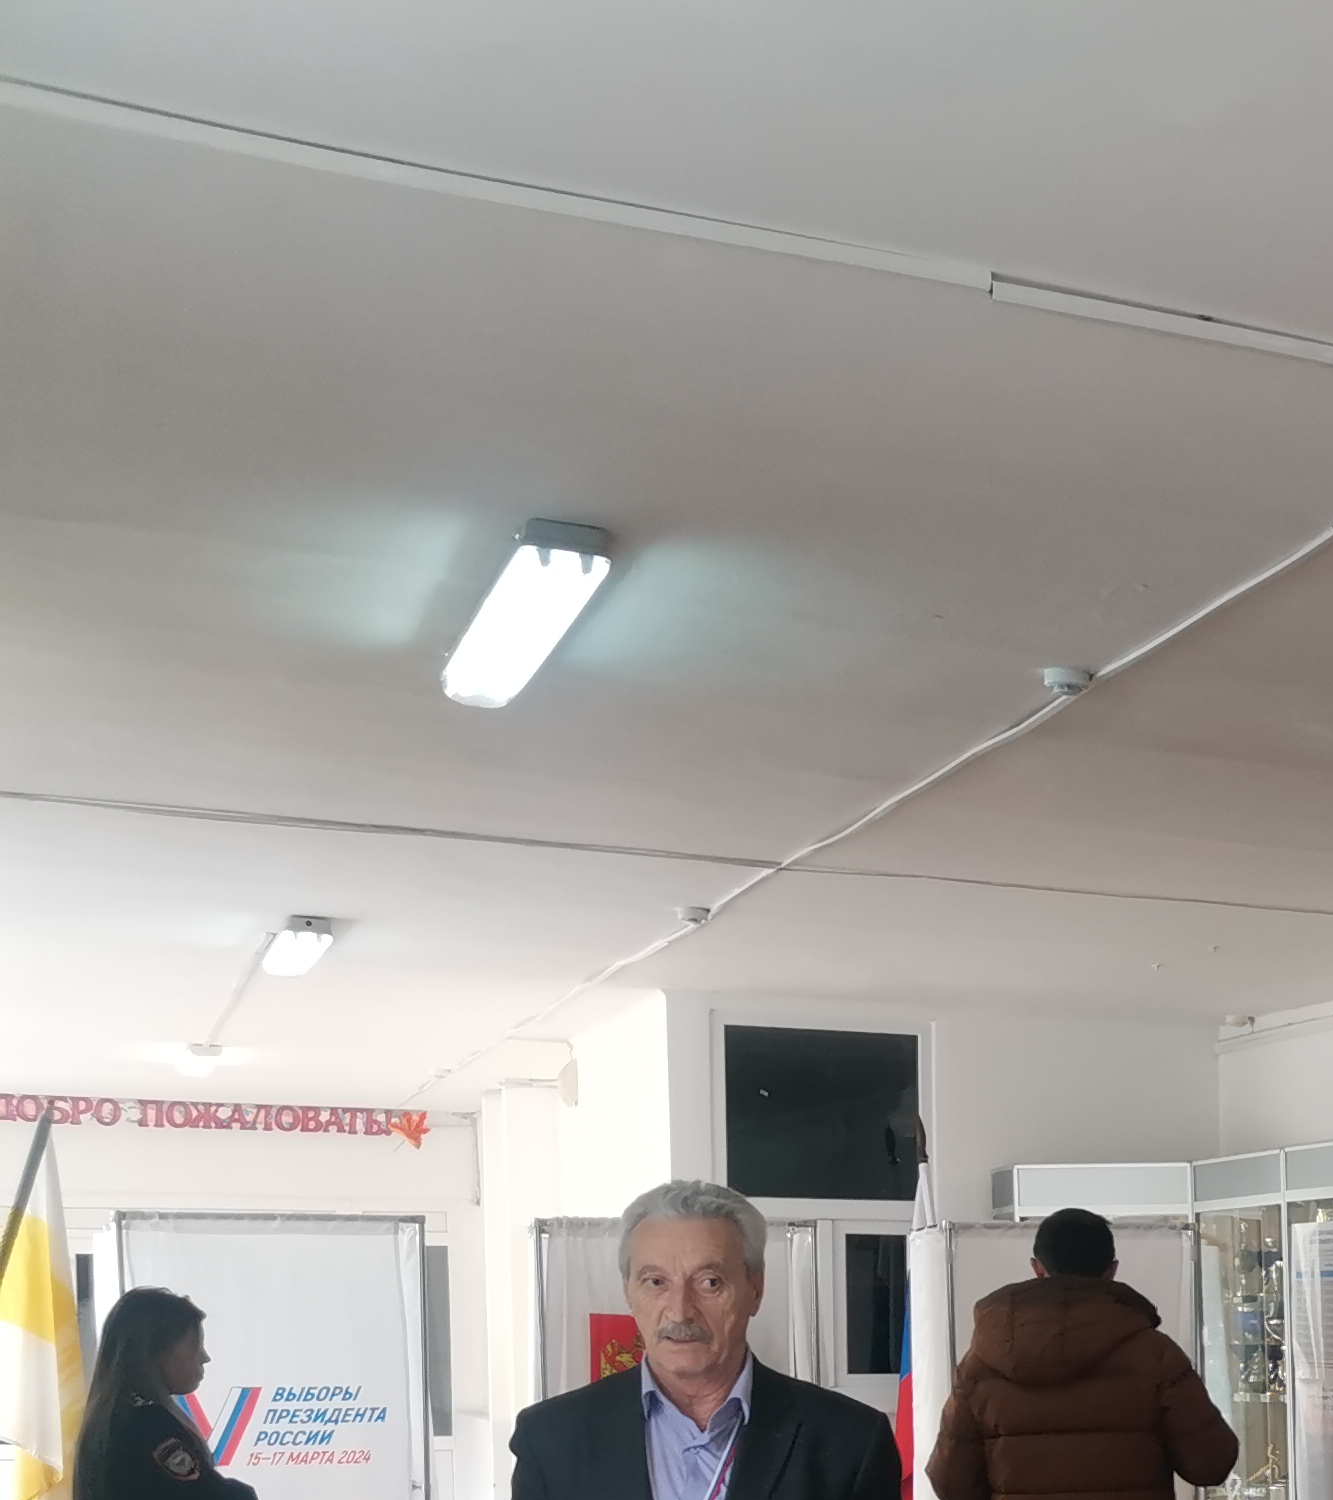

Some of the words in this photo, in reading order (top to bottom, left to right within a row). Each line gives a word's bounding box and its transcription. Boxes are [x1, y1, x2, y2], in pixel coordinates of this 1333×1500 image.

[271, 1386, 362, 1402] ВЫБОРЫ
[263, 1407, 388, 1426] ПРЕЗИДЕНТА
[254, 1430, 334, 1447] РОССИИ
[286, 1451, 335, 1465] МАРТА
[337, 1450, 372, 1464] 2024
